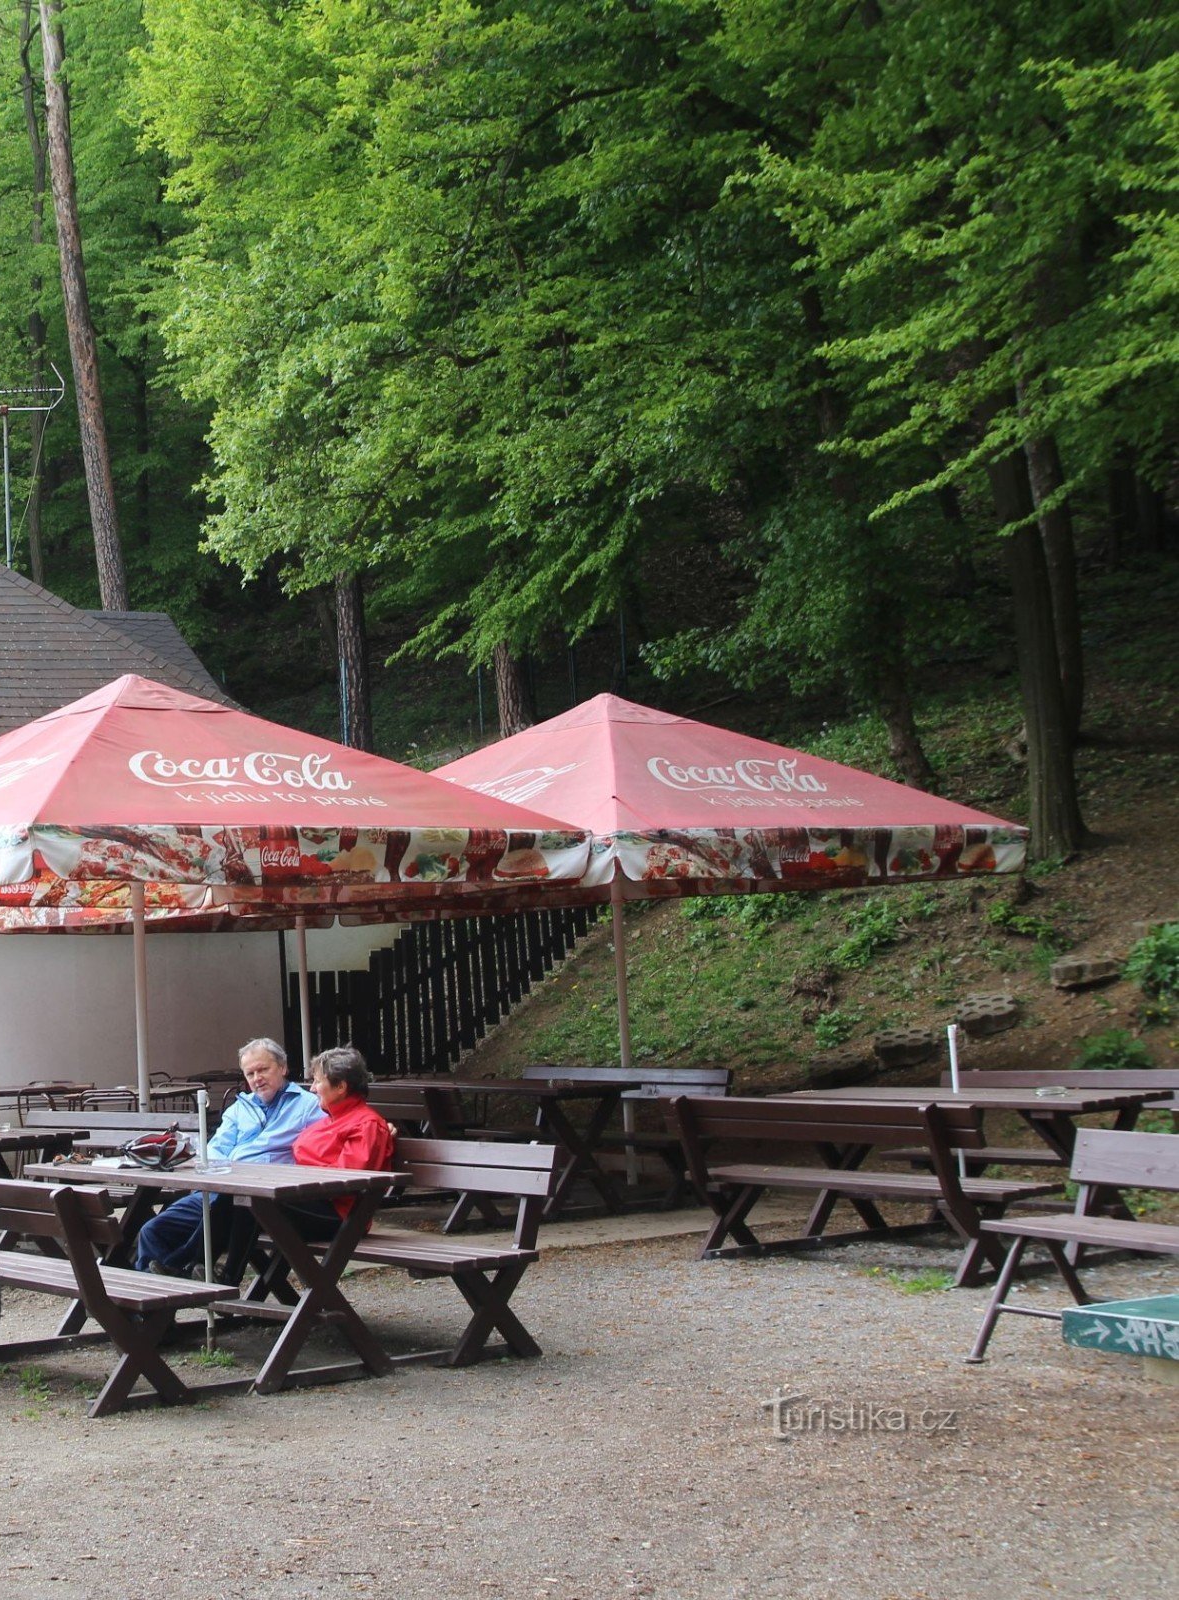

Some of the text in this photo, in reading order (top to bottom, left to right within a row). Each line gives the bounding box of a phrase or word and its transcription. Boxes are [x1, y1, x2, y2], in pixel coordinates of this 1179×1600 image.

[128, 750, 354, 790] Coca-Cola
[646, 756, 828, 793] Coca-Cola
[175, 790, 389, 808] k jídlu to pravé
[262, 845, 301, 868] Coca-Cola
